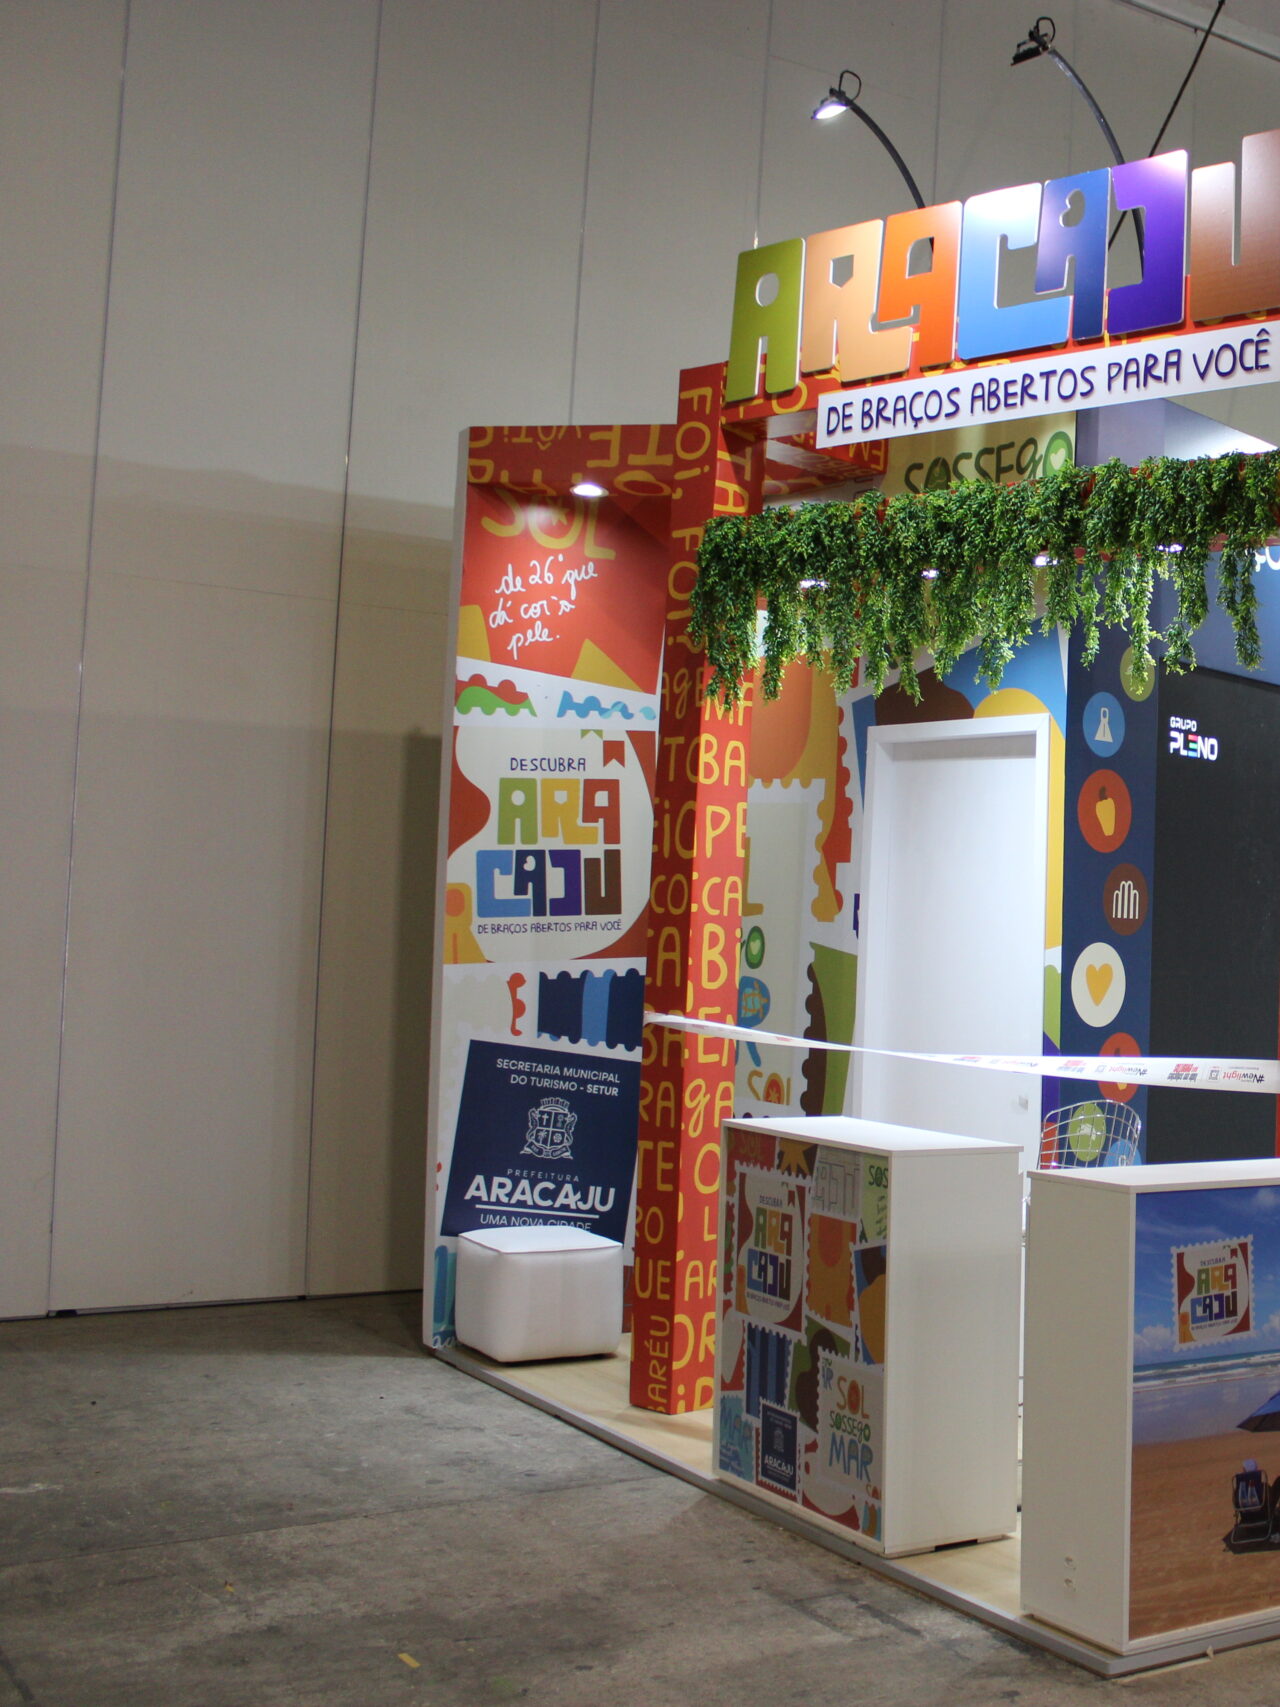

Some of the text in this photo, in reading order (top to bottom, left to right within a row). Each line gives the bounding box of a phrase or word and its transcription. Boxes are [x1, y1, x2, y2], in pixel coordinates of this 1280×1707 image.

[827, 329, 1271, 435] DE BRAÇOS ABERTOS PARA VOCÊ
[495, 563, 526, 594] de
[561, 562, 598, 600] que
[489, 598, 513, 628] dá
[520, 600, 550, 619] cor
[1170, 716, 1197, 732] GRUPO
[1170, 731, 1218, 761] PLENO
[510, 757, 586, 772] DESCUBRA
[497, 777, 621, 845] ARA
[476, 849, 622, 918] CAJU
[478, 918, 622, 935] DE BRAÇOS ABERTOS PARA VOCÊ
[496, 1058, 620, 1083] SECRETARIA MUNICIPAL
[510, 1074, 528, 1085] DO
[530, 1076, 577, 1092] TURISMO
[586, 1084, 619, 1097] SETUR
[507, 1169, 580, 1182] PREFEITURA
[464, 1174, 616, 1212] ARACAJU
[480, 1213, 508, 1225] UMA
[510, 1217, 544, 1227] NOVA
[754, 1206, 793, 1256] ARA
[747, 1248, 792, 1301] CAJU
[1197, 1263, 1238, 1295] ARA
[1190, 1291, 1238, 1324] CAJU
[648, 1316, 670, 1413] ARÉU
[836, 1375, 870, 1419] SOL
[828, 1432, 873, 1482] MAR
